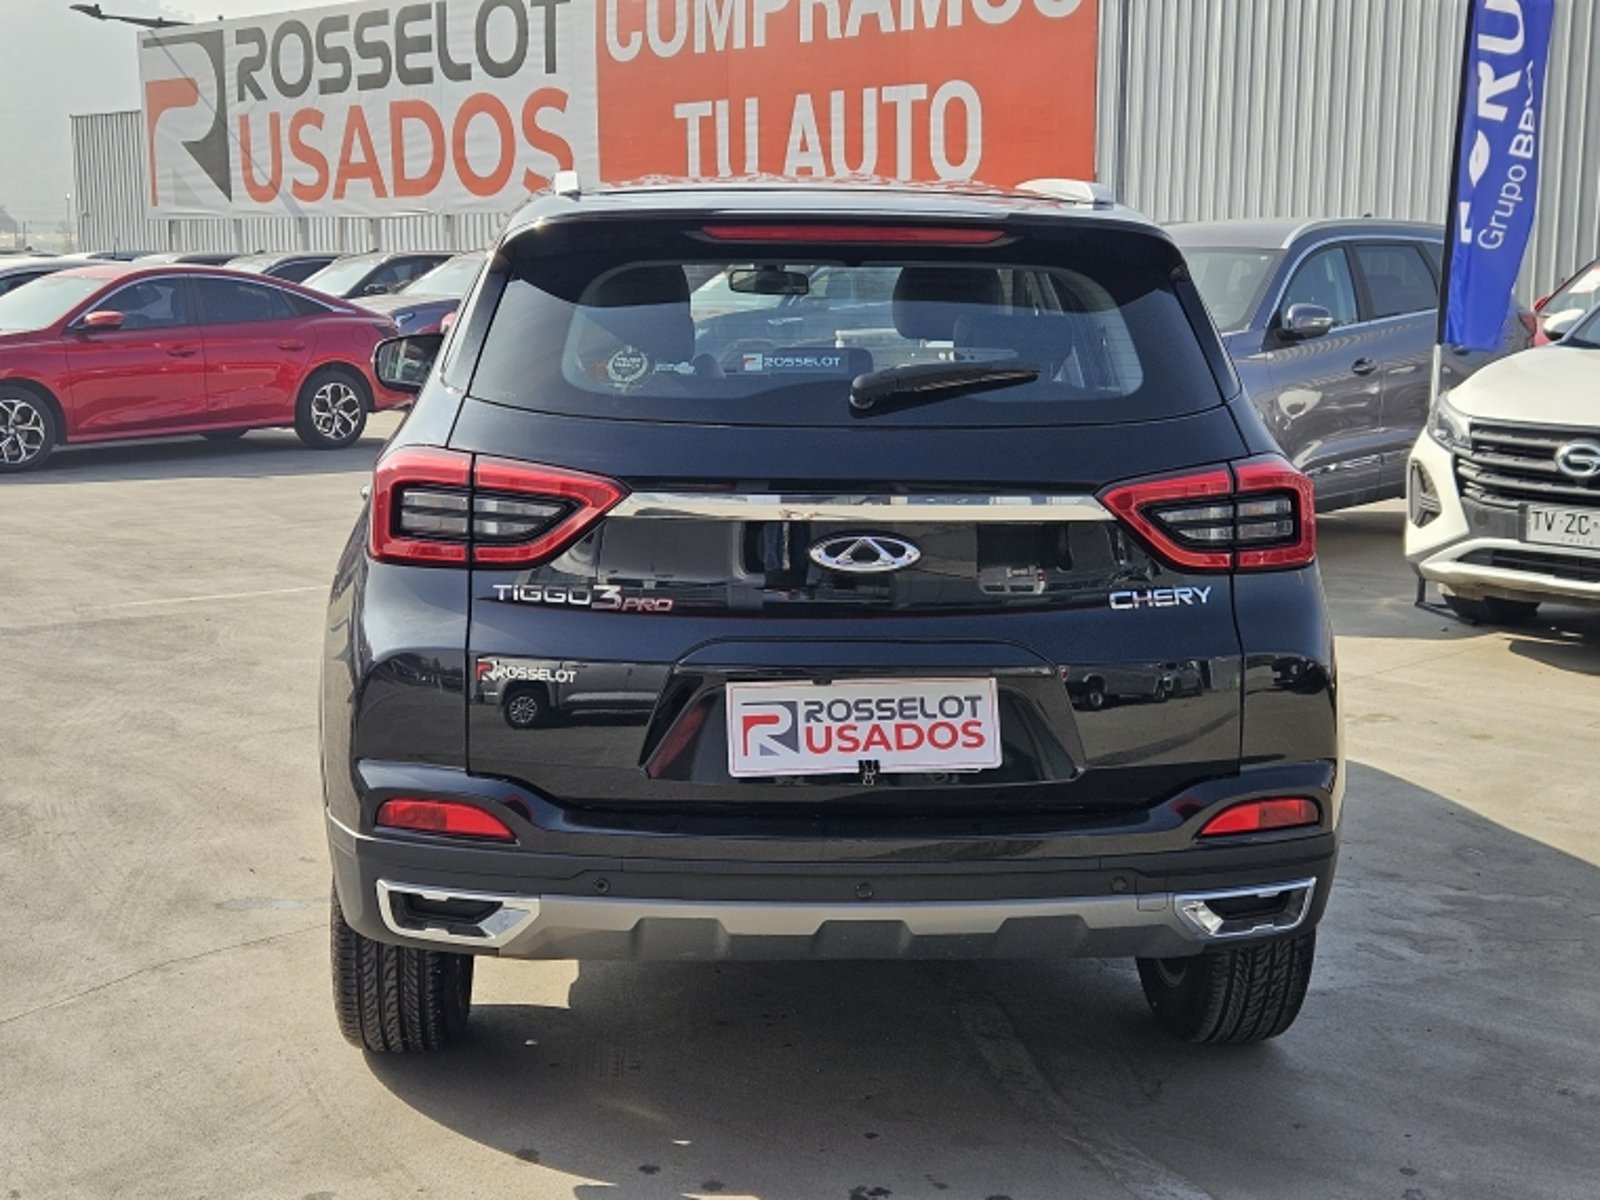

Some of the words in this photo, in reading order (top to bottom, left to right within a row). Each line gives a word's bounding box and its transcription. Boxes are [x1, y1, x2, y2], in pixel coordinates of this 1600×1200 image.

[235, 0, 571, 102] ROSSELOT
[239, 87, 574, 204] USADOS
[674, 98, 759, 179] TU
[783, 79, 982, 181] AUTO
[1477, 164, 1527, 249] Grupo
[764, 357, 840, 368] ROSSELOT
[492, 584, 591, 605] TIGGO
[1109, 586, 1212, 609] CHERY
[498, 665, 577, 683] ROSSELOT
[803, 695, 983, 724] ROSSELOT
[805, 720, 986, 754] USADOS
